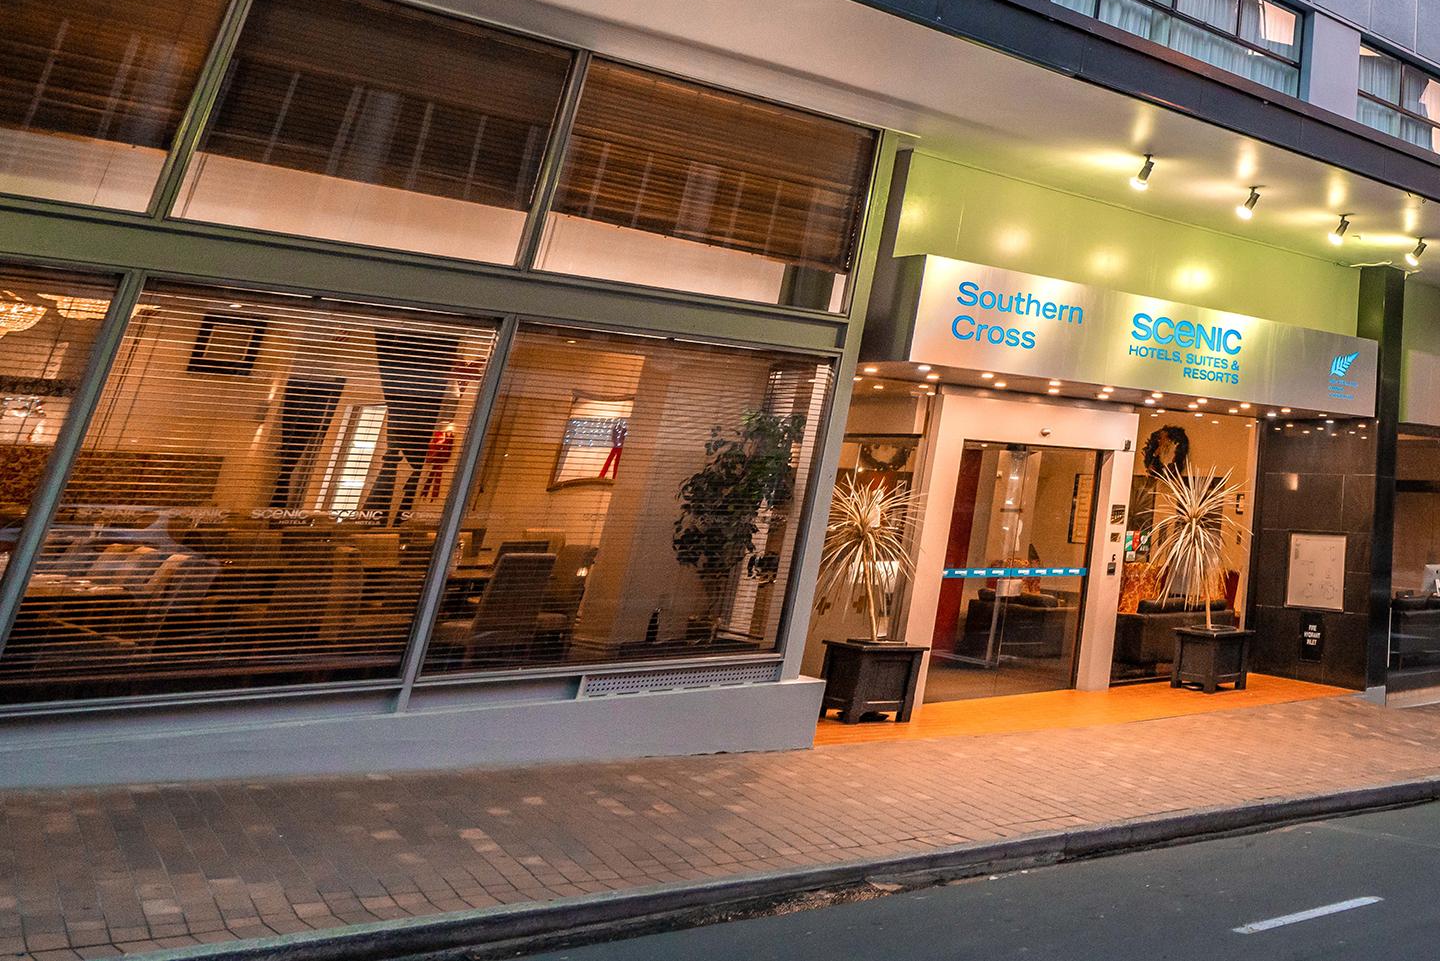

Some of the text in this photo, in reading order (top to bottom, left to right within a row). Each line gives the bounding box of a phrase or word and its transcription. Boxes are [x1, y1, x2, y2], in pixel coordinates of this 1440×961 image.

[956, 281, 1084, 325] Southern
[951, 314, 1036, 350] Cross
[1128, 344, 1240, 371] HOTELS, SUITES &
[1183, 366, 1240, 385] RESORTS
